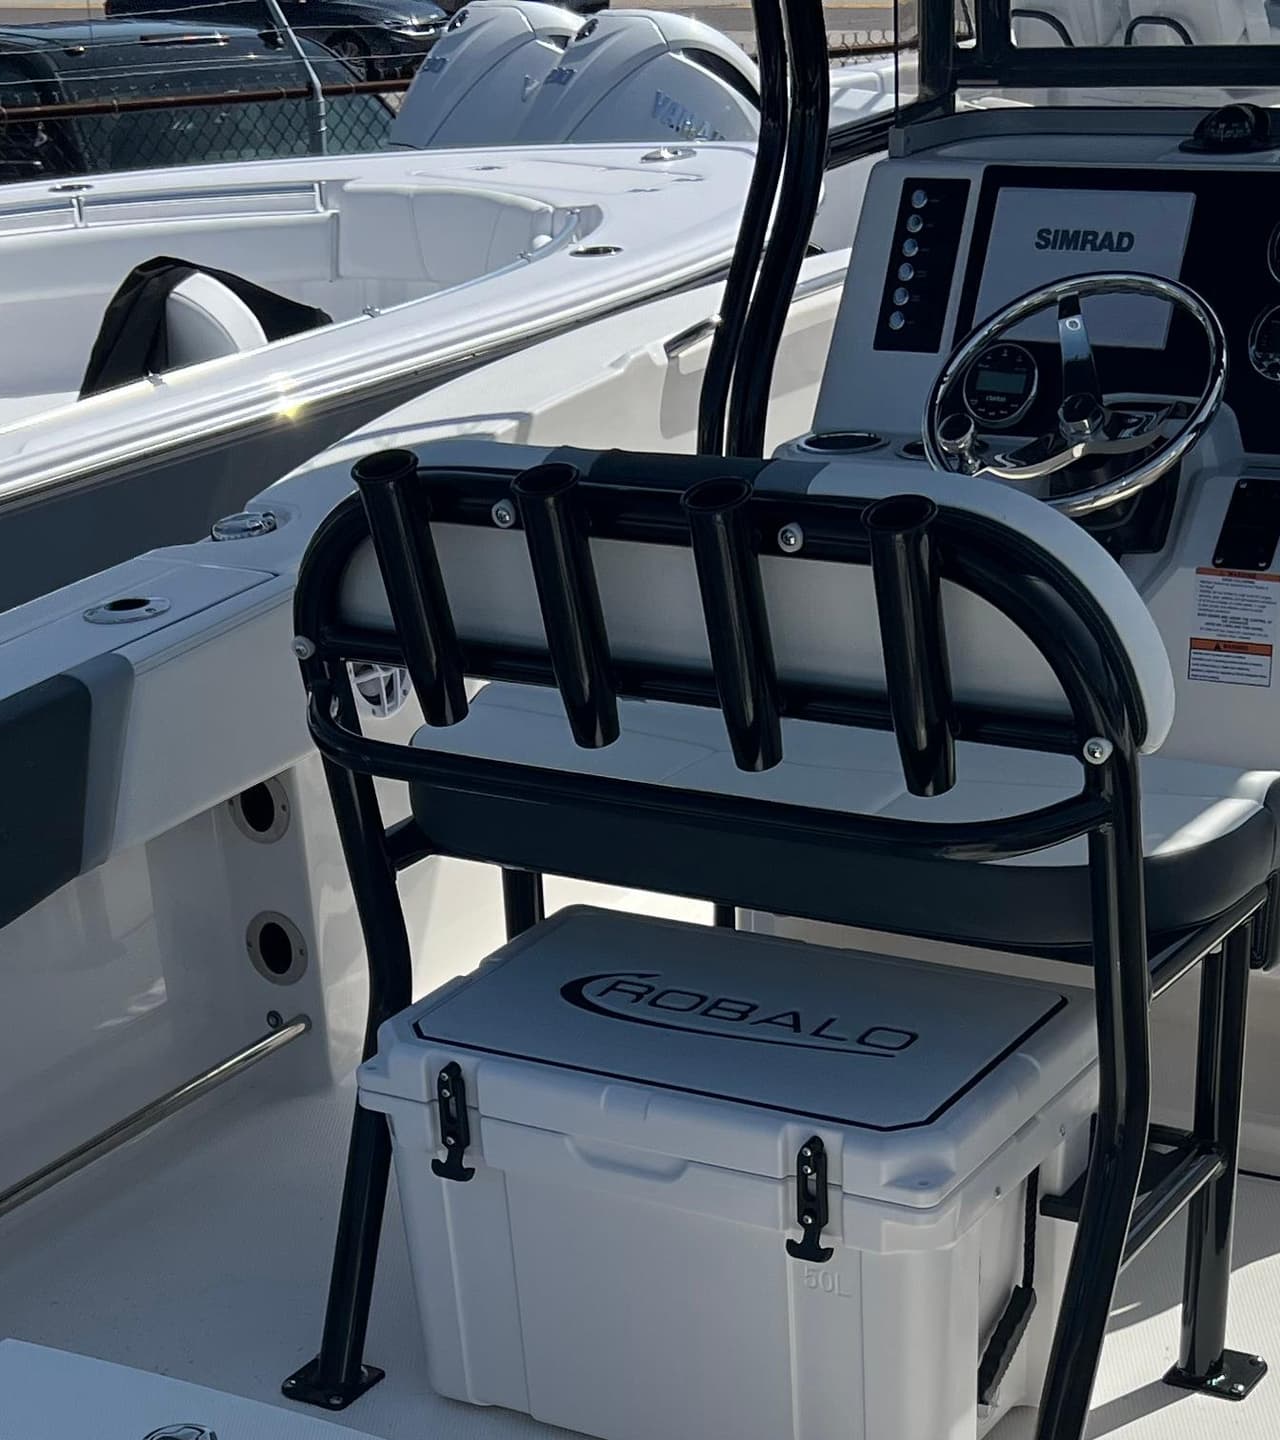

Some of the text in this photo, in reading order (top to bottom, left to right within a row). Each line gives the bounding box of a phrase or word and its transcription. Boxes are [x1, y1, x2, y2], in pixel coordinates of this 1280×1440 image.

[1034, 227, 1135, 253] SIMRAD
[596, 979, 919, 1052] ROBALO
[800, 1264, 854, 1298] 50L
